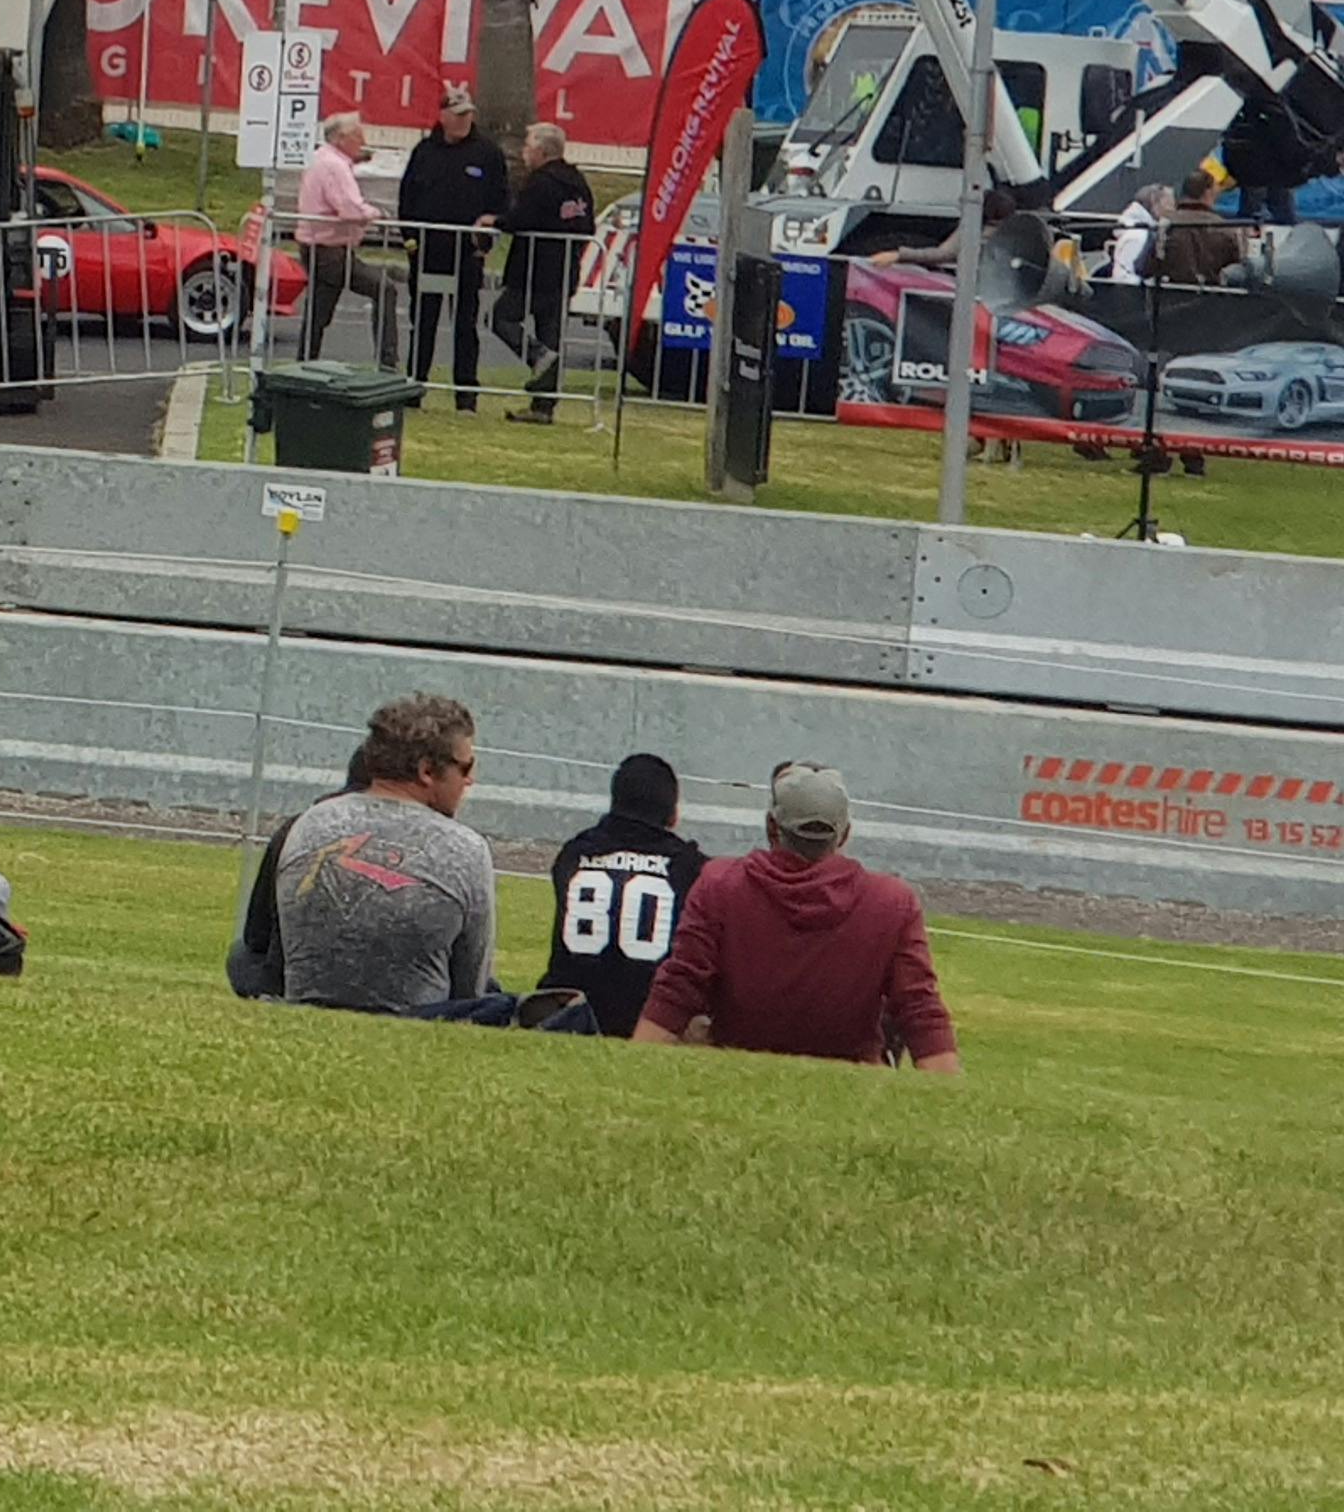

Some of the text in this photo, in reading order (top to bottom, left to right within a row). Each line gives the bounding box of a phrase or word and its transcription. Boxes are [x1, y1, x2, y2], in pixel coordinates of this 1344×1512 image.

[692, 19, 741, 117] REVIVAL
[290, 99, 306, 119] P
[664, 322, 707, 338] GULF
[1243, 818, 1270, 841] 13
[1277, 820, 1305, 844] 15
[1312, 823, 1342, 848] 52
[562, 869, 675, 961] 80
